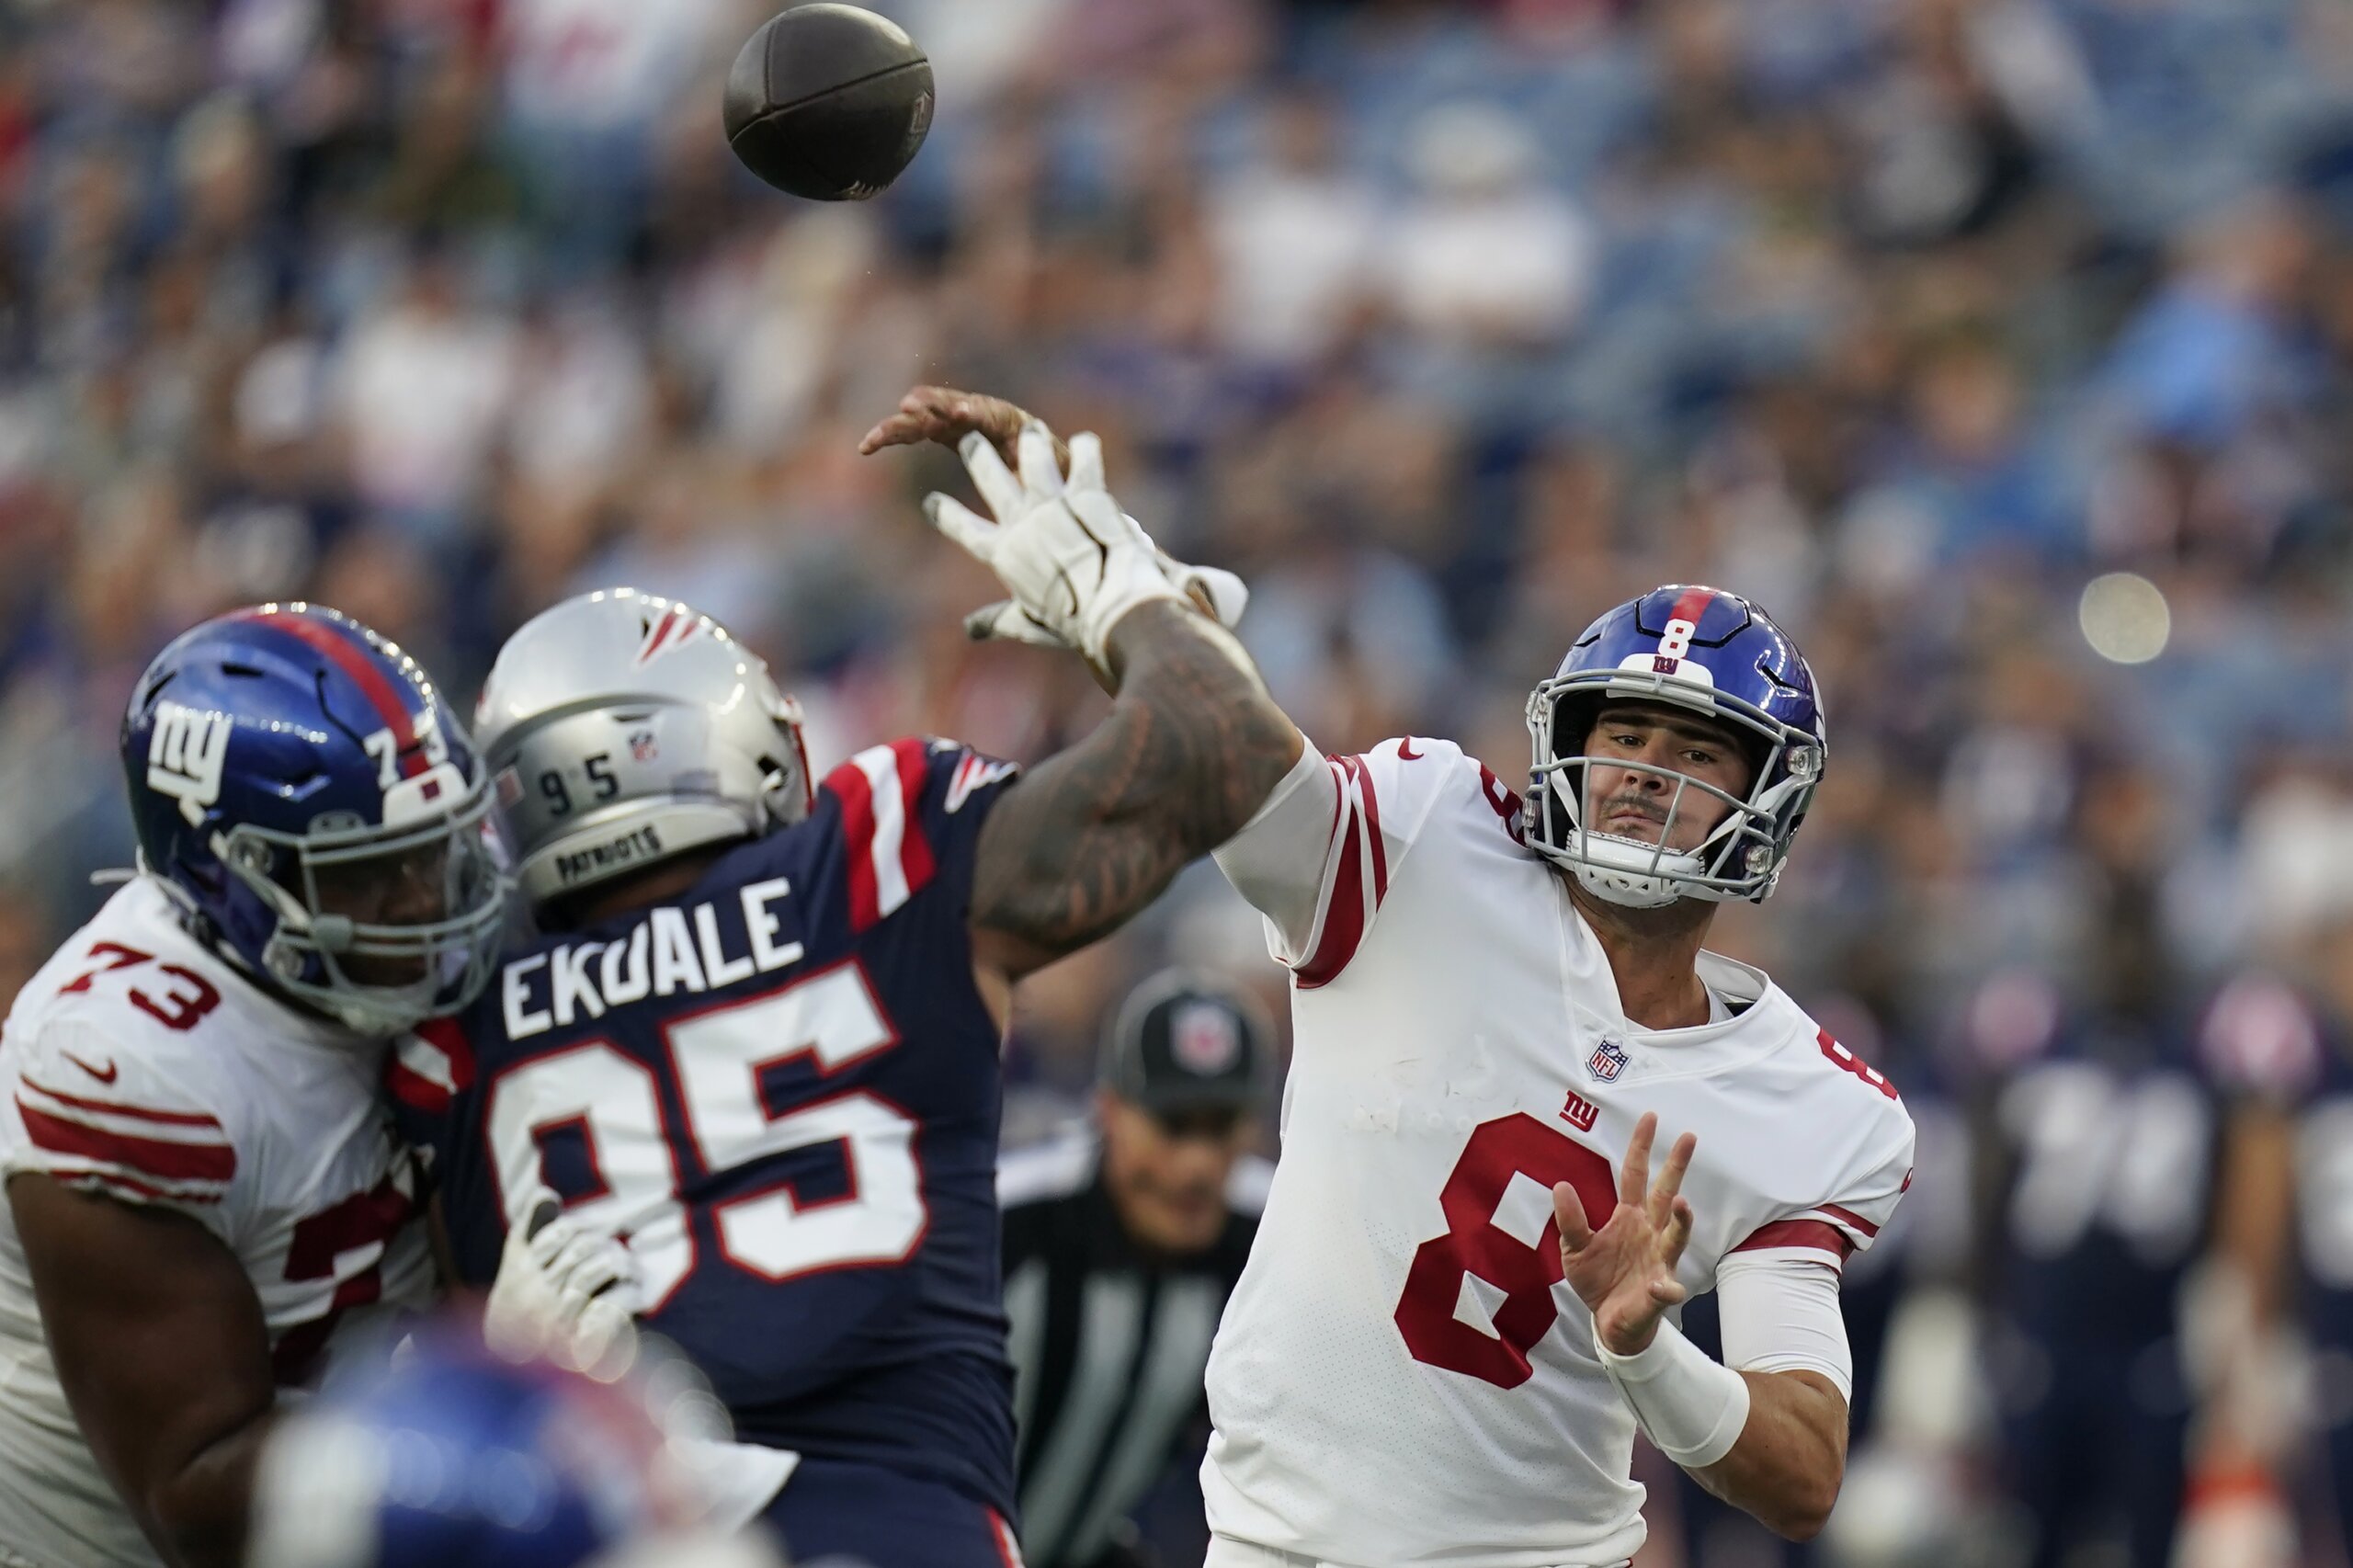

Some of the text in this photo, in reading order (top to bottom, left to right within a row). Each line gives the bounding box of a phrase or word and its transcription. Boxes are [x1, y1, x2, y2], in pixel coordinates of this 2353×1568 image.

[1657, 618, 1697, 659] 8
[362, 705, 450, 791] 73
[539, 752, 620, 816] 95
[555, 823, 662, 882] PATRIOTS
[57, 941, 222, 1033] 73
[502, 877, 805, 1040] EKUALE
[1591, 1051, 1618, 1078] NFL
[484, 953, 932, 1320] 95
[1393, 1111, 1620, 1391] 8
